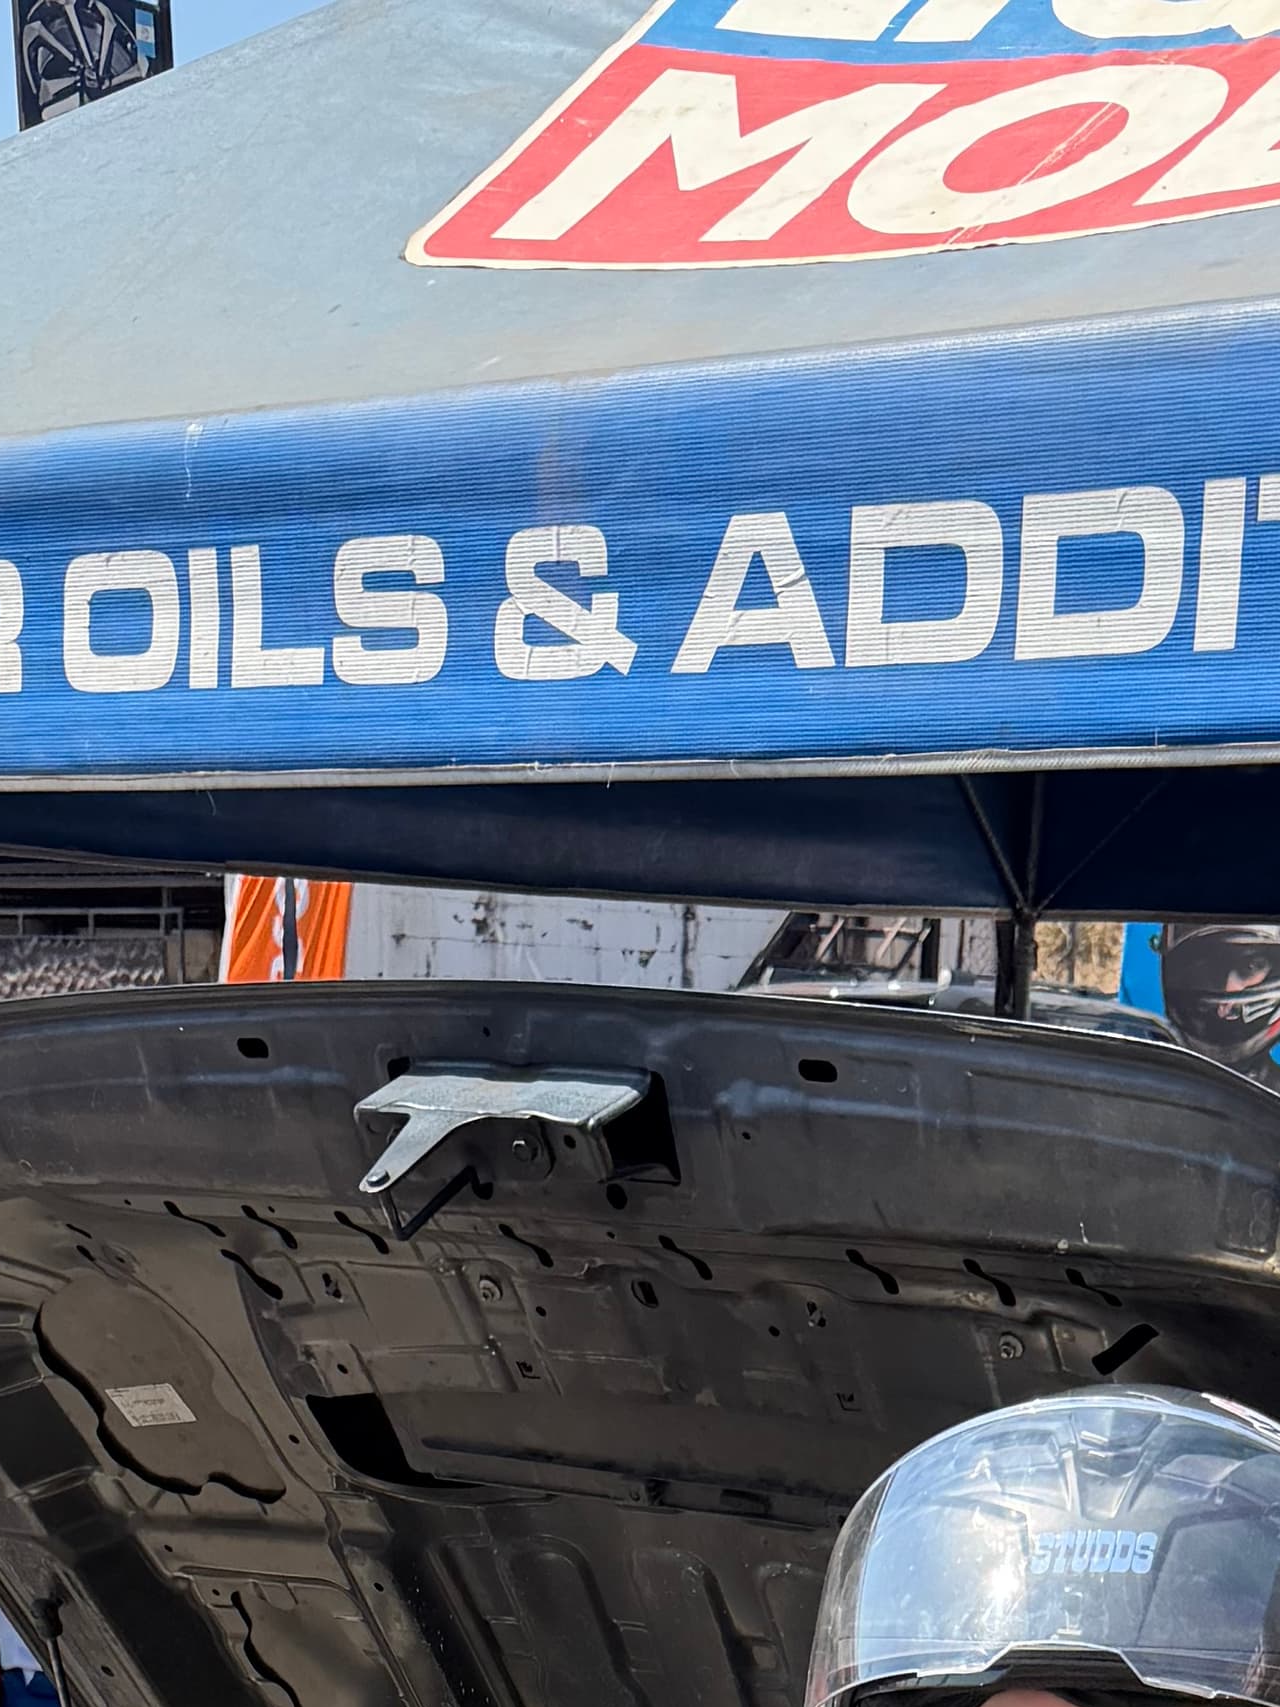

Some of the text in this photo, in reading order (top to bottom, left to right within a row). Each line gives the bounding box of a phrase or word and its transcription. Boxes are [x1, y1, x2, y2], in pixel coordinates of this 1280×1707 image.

[63, 533, 449, 694] OILS
[494, 524, 634, 679] &
[1029, 1531, 1157, 1575] STUDDS
